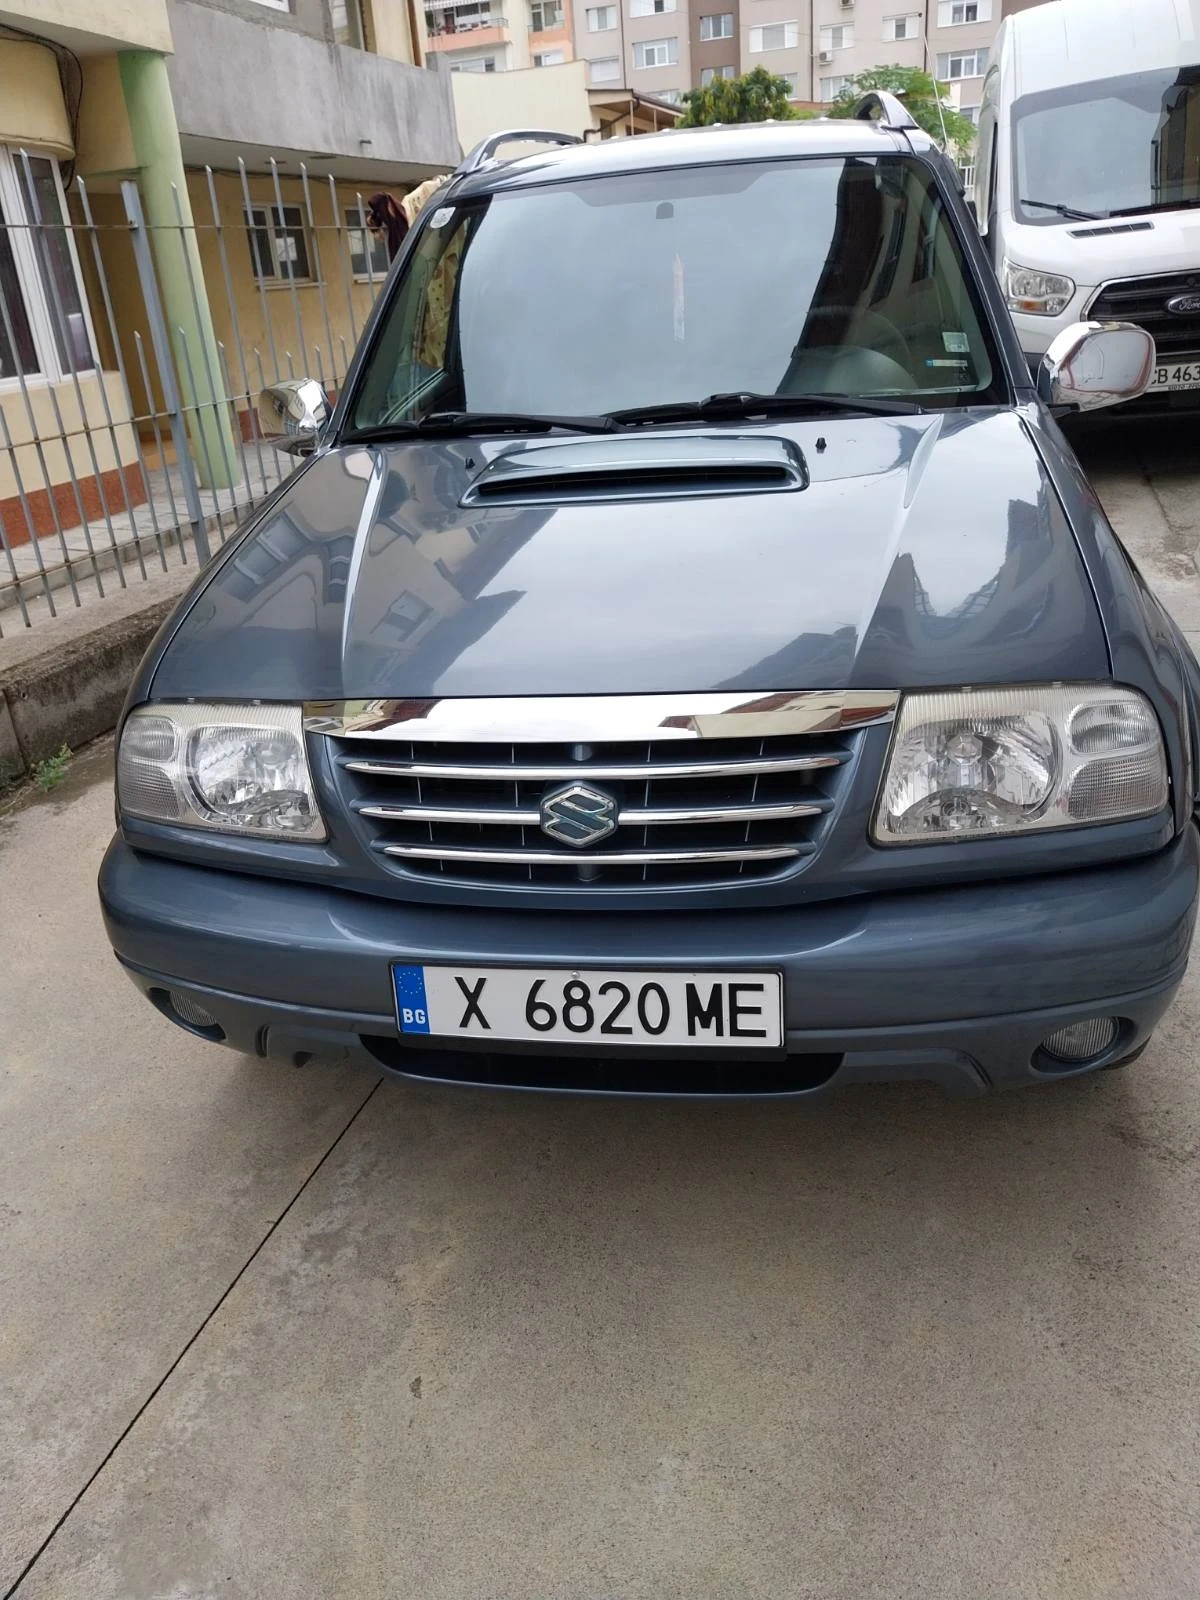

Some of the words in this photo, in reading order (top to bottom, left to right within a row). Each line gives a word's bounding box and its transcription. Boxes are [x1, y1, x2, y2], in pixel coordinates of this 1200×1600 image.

[1172, 365, 1200, 382] 463
[454, 976, 491, 1029] X
[525, 979, 670, 1035] 6820
[686, 982, 767, 1038] ME
[402, 1008, 426, 1025] BG
